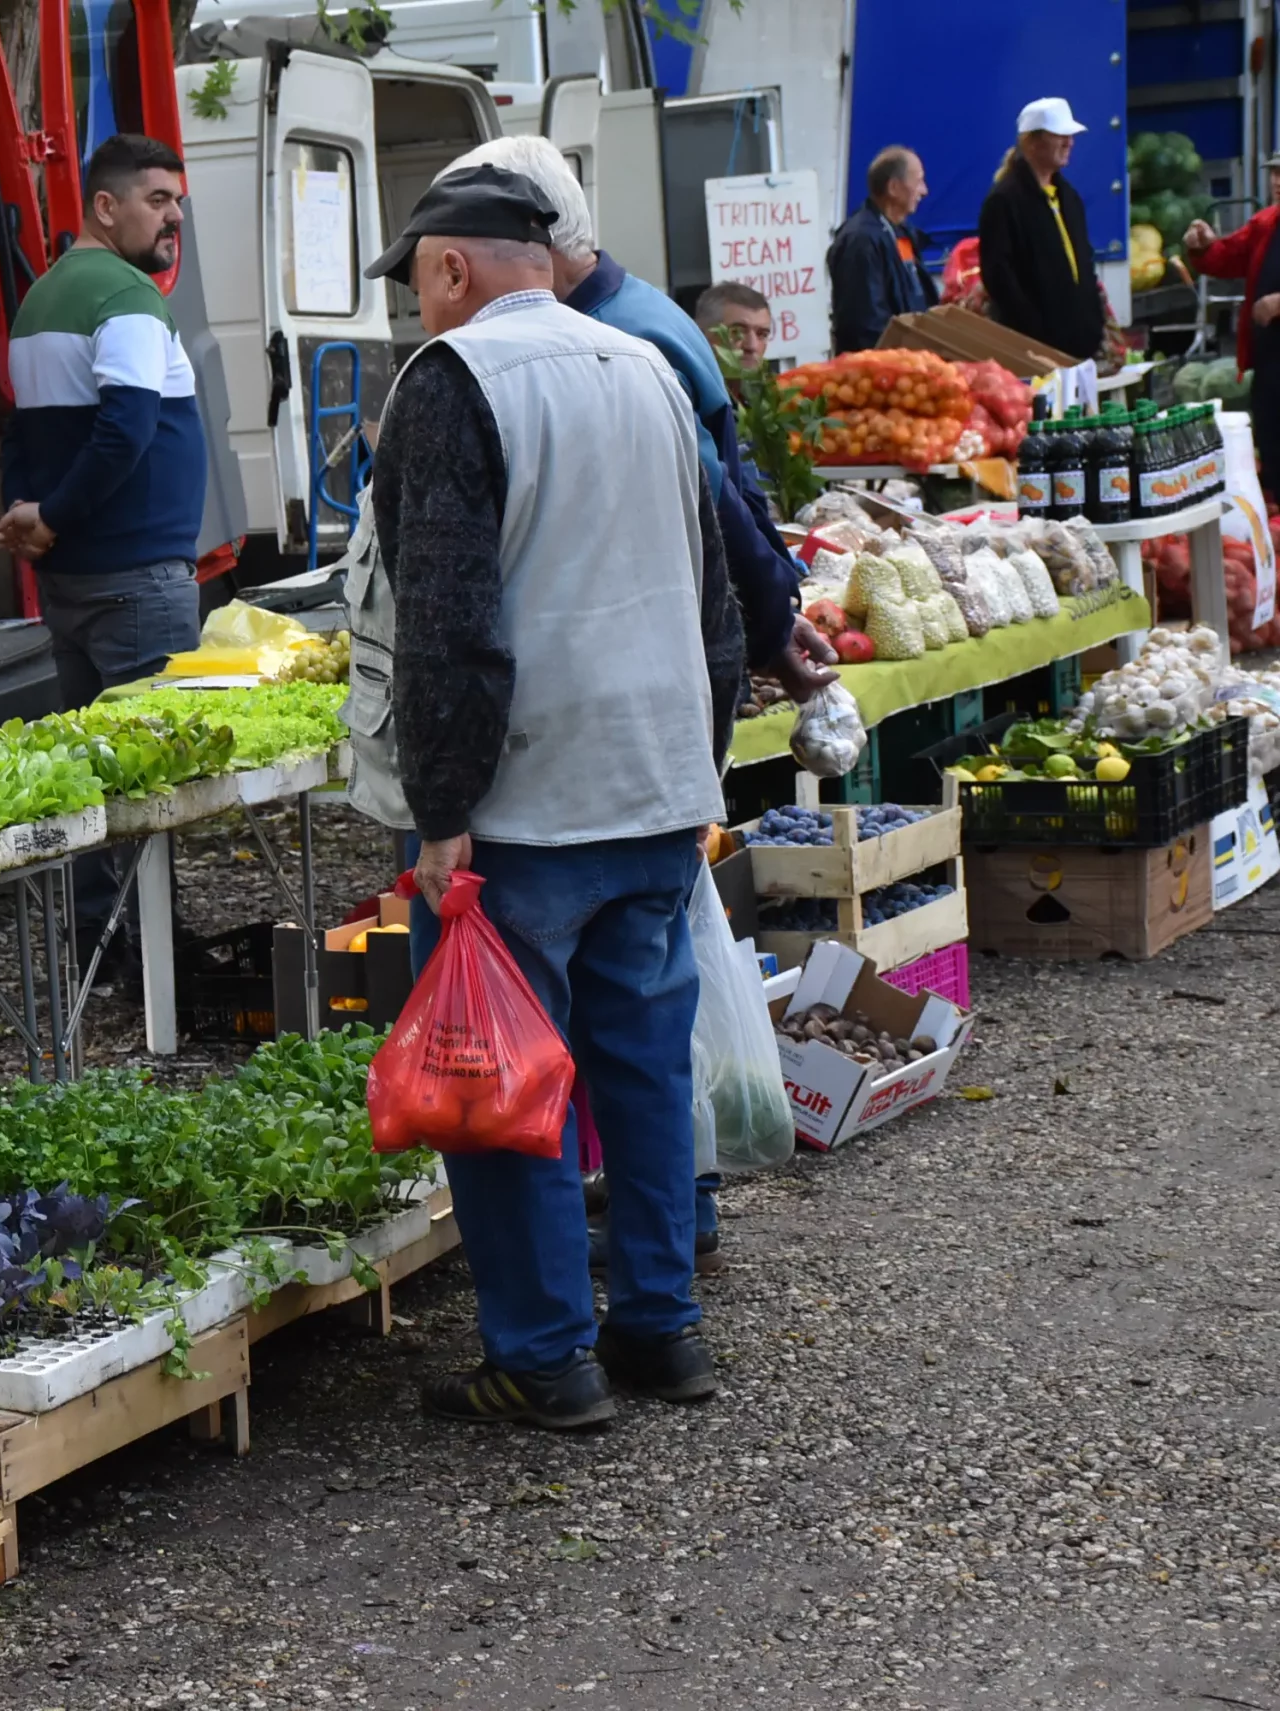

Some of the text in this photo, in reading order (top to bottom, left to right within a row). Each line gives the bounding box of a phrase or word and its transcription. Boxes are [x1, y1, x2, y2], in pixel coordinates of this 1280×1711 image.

[713, 202, 811, 226] TRITIKAL
[719, 237, 793, 269] JEČAM
[724, 268, 816, 299] KURUZ
